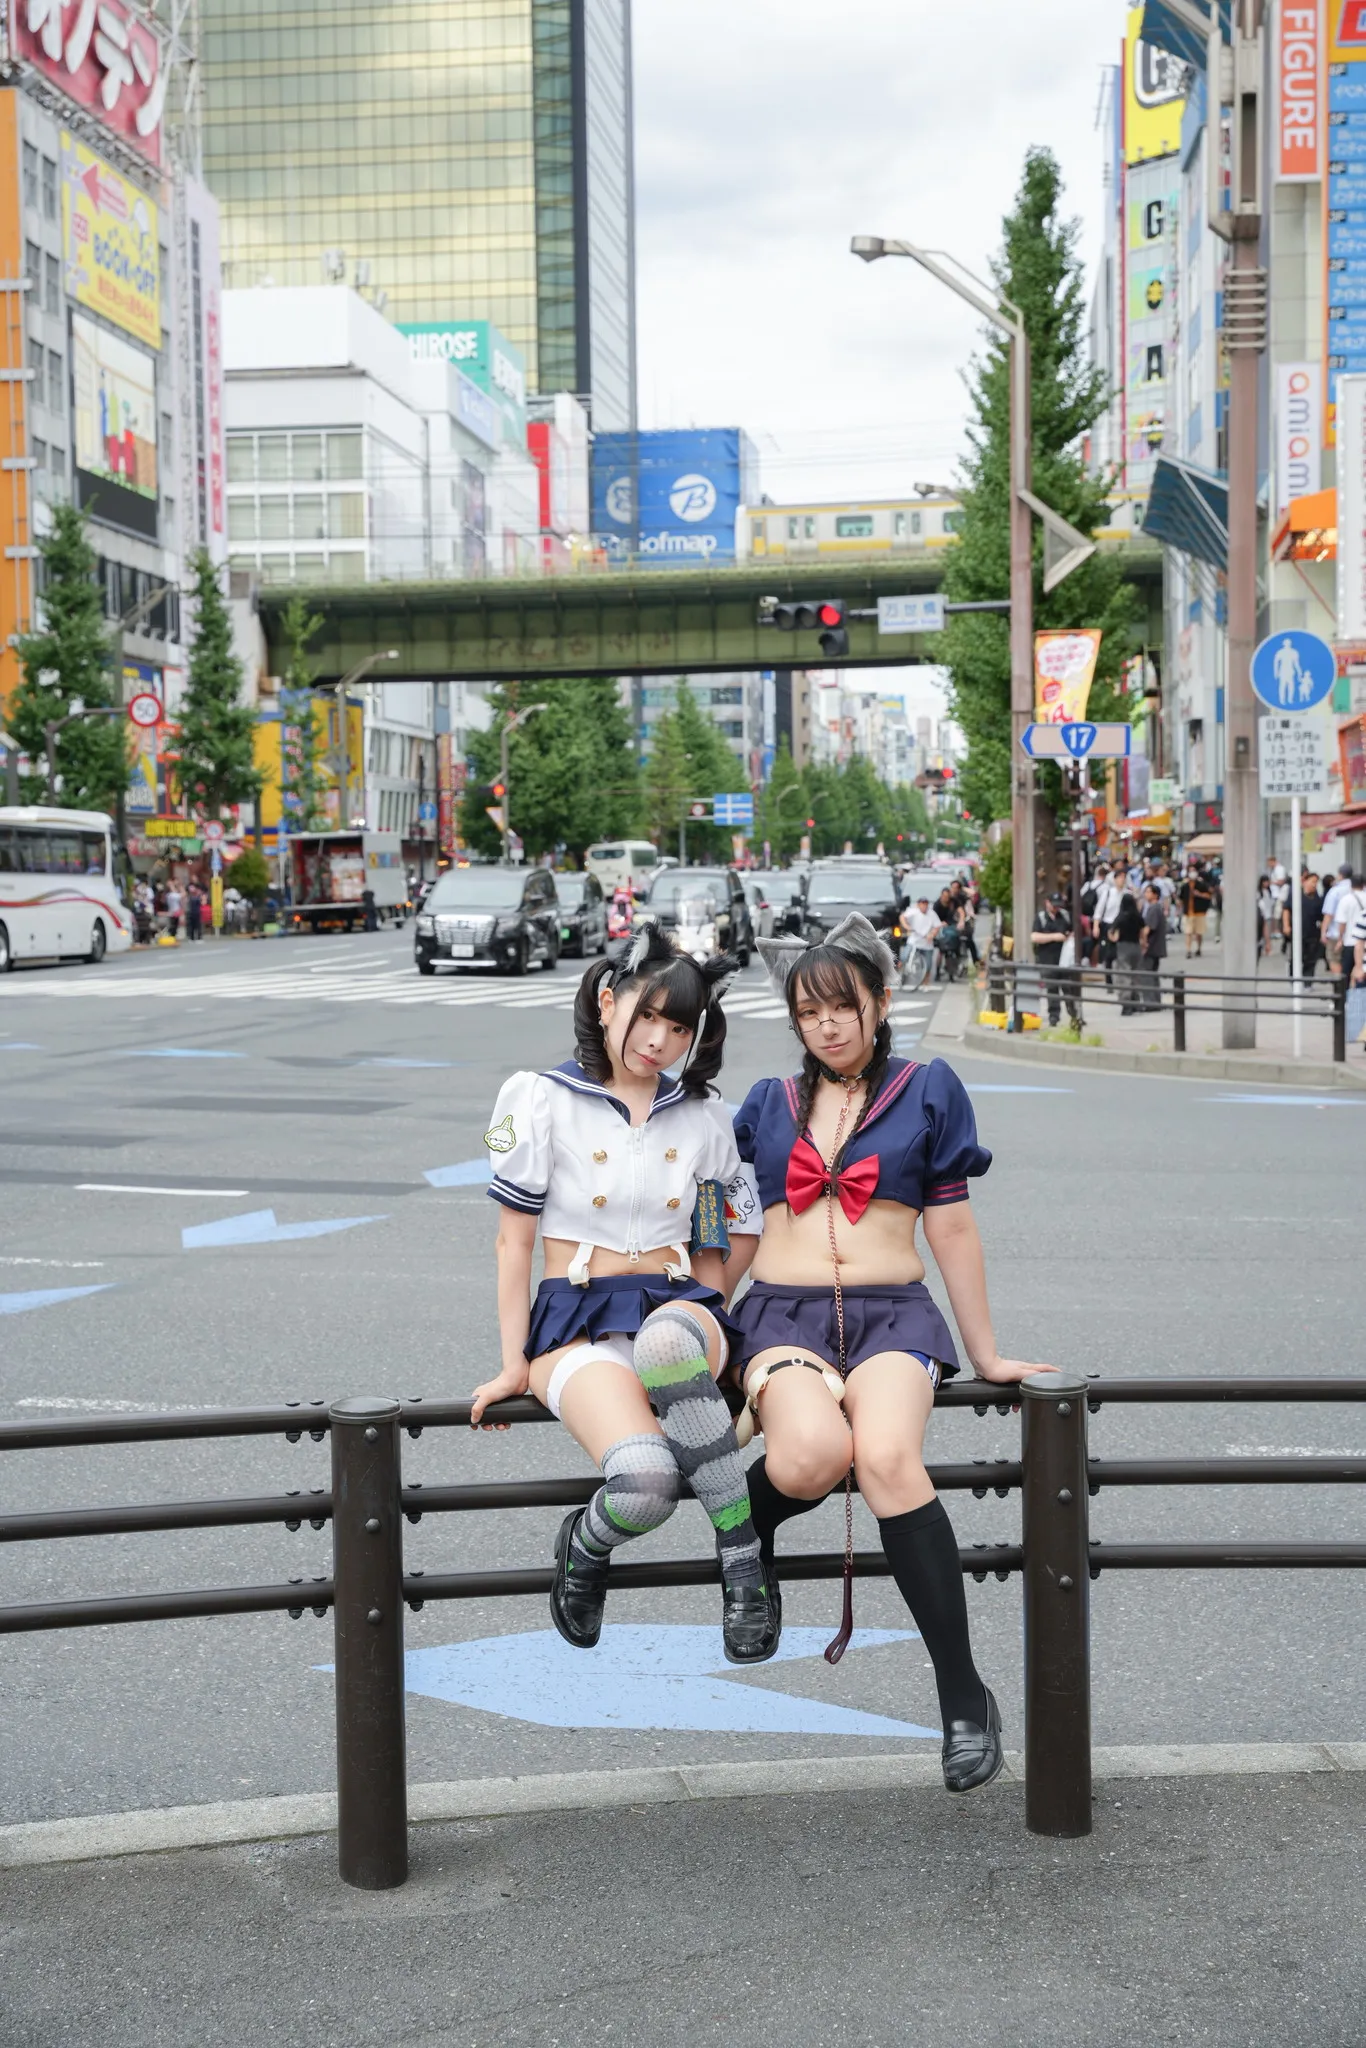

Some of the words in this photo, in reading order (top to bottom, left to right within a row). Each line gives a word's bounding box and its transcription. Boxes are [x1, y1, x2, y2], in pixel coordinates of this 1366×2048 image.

[1282, 8, 1315, 150] FIGURE
[407, 331, 478, 361] HIROSE
[135, 702, 156, 718] 50
[1069, 727, 1092, 749] 17
